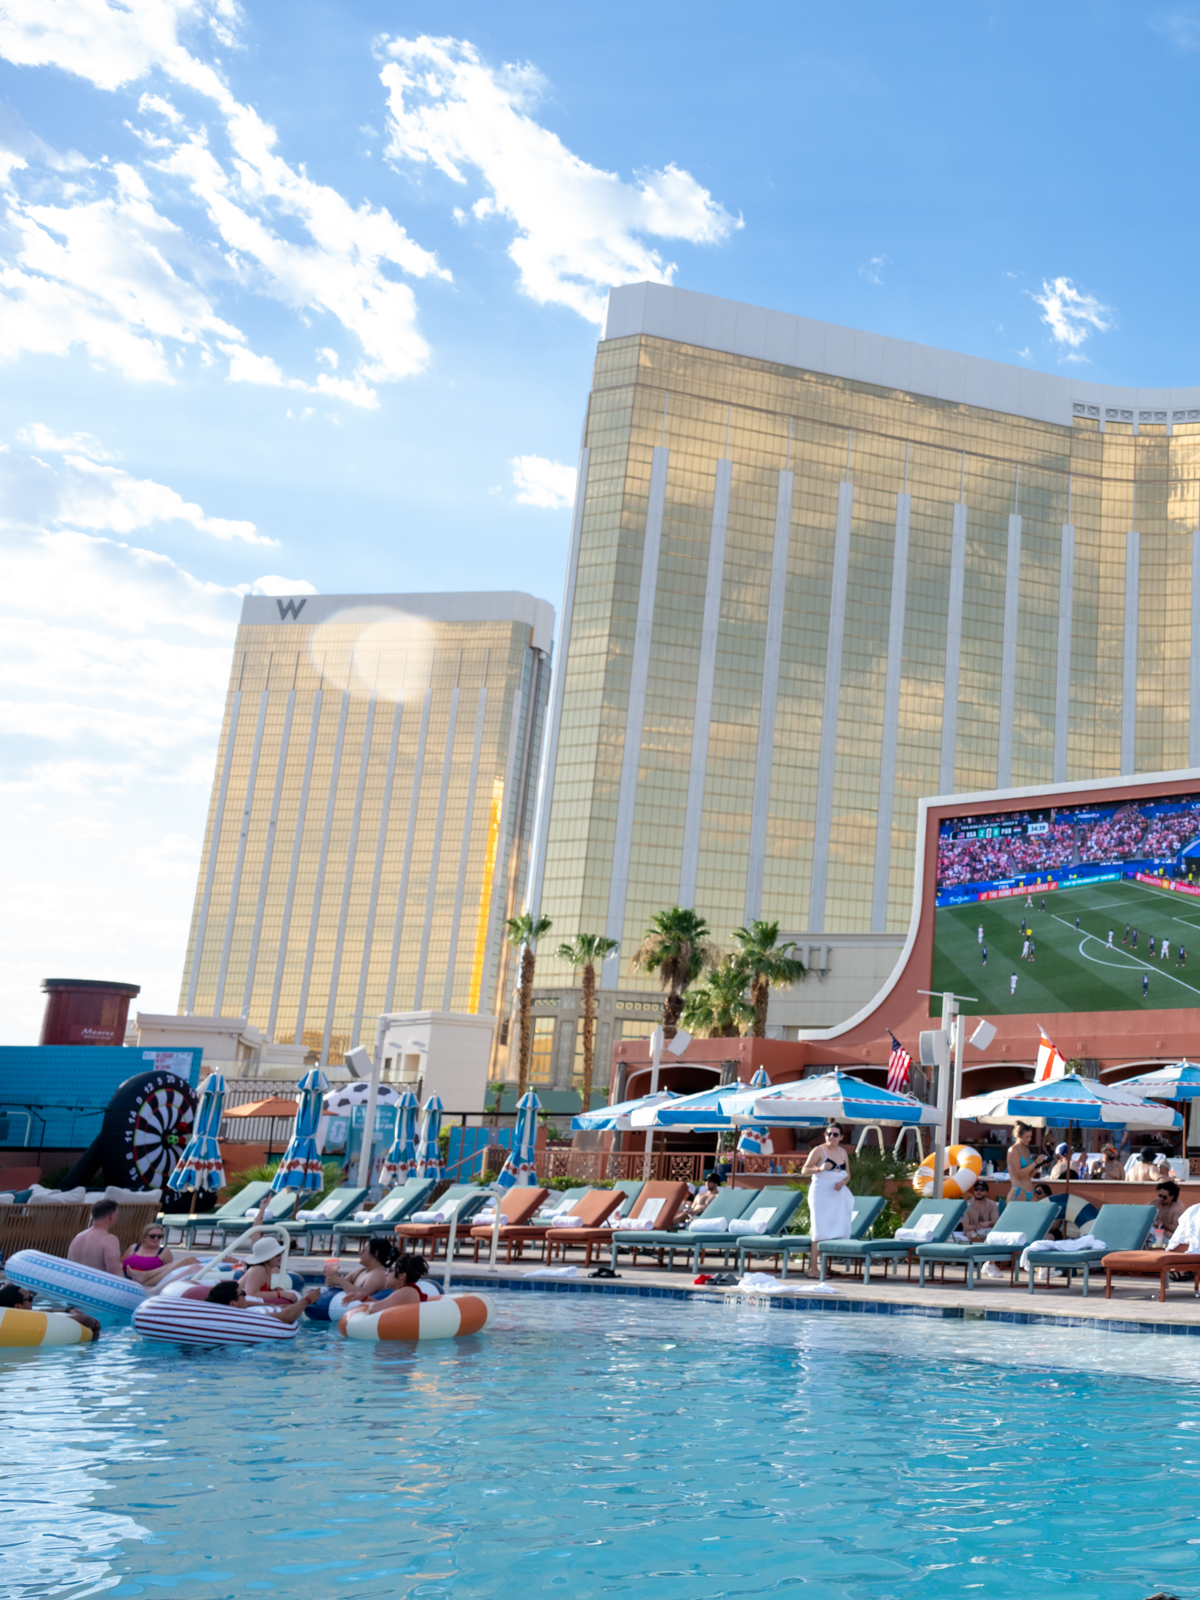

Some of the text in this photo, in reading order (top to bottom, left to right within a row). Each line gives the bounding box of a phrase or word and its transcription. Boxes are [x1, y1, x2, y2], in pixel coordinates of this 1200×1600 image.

[276, 598, 307, 621] W
[1013, 887, 1027, 895] DEPOT
[1028, 885, 1048, 893] DELIVERS
[157, 1077, 163, 1085] 5
[167, 1075, 175, 1083] 20
[144, 1083, 154, 1094] 12
[136, 1096, 142, 1104] 9
[129, 1110, 137, 1124] 14
[125, 1130, 133, 1143] 11
[126, 1152, 133, 1160] 8
[129, 1167, 138, 1180] 16
